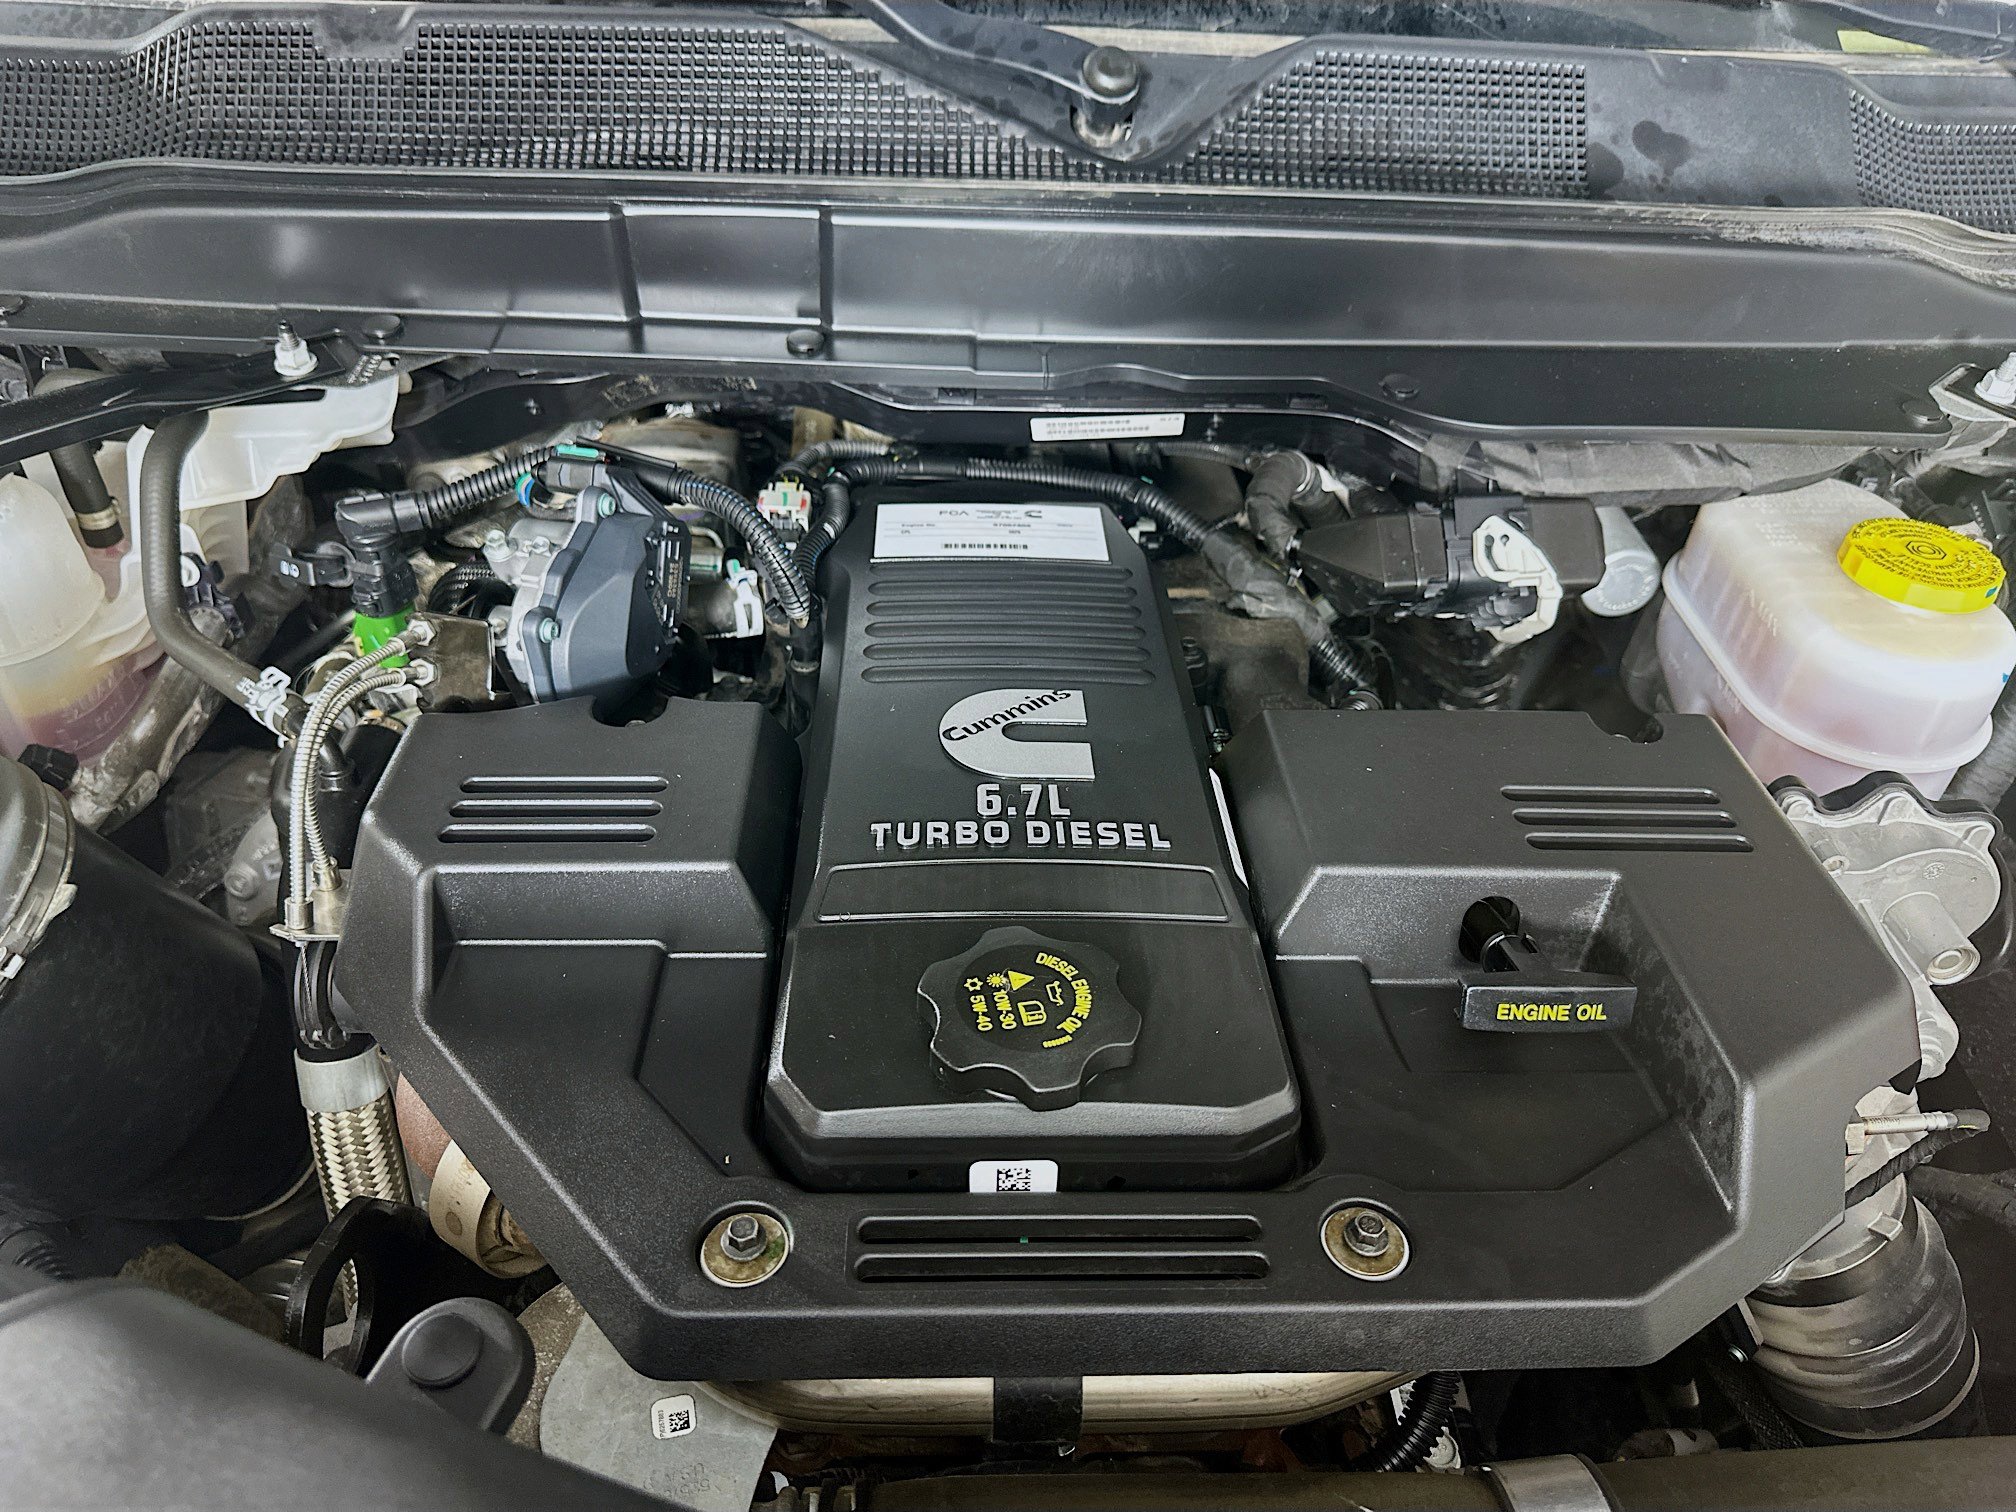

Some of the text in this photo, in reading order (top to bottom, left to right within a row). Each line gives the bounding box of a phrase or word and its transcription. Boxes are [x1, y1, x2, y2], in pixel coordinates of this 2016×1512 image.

[942, 689, 1072, 742] Cummins
[976, 783, 1071, 818] 6.7L
[870, 820, 1171, 851] TURBO DIESEL
[992, 989, 1017, 1030] 10W-30
[1035, 952, 1093, 1034] DIESEL ENGINE OIL
[1496, 1003, 1607, 1021] ENGINE OIL
[969, 994, 994, 1032] 5W-40
